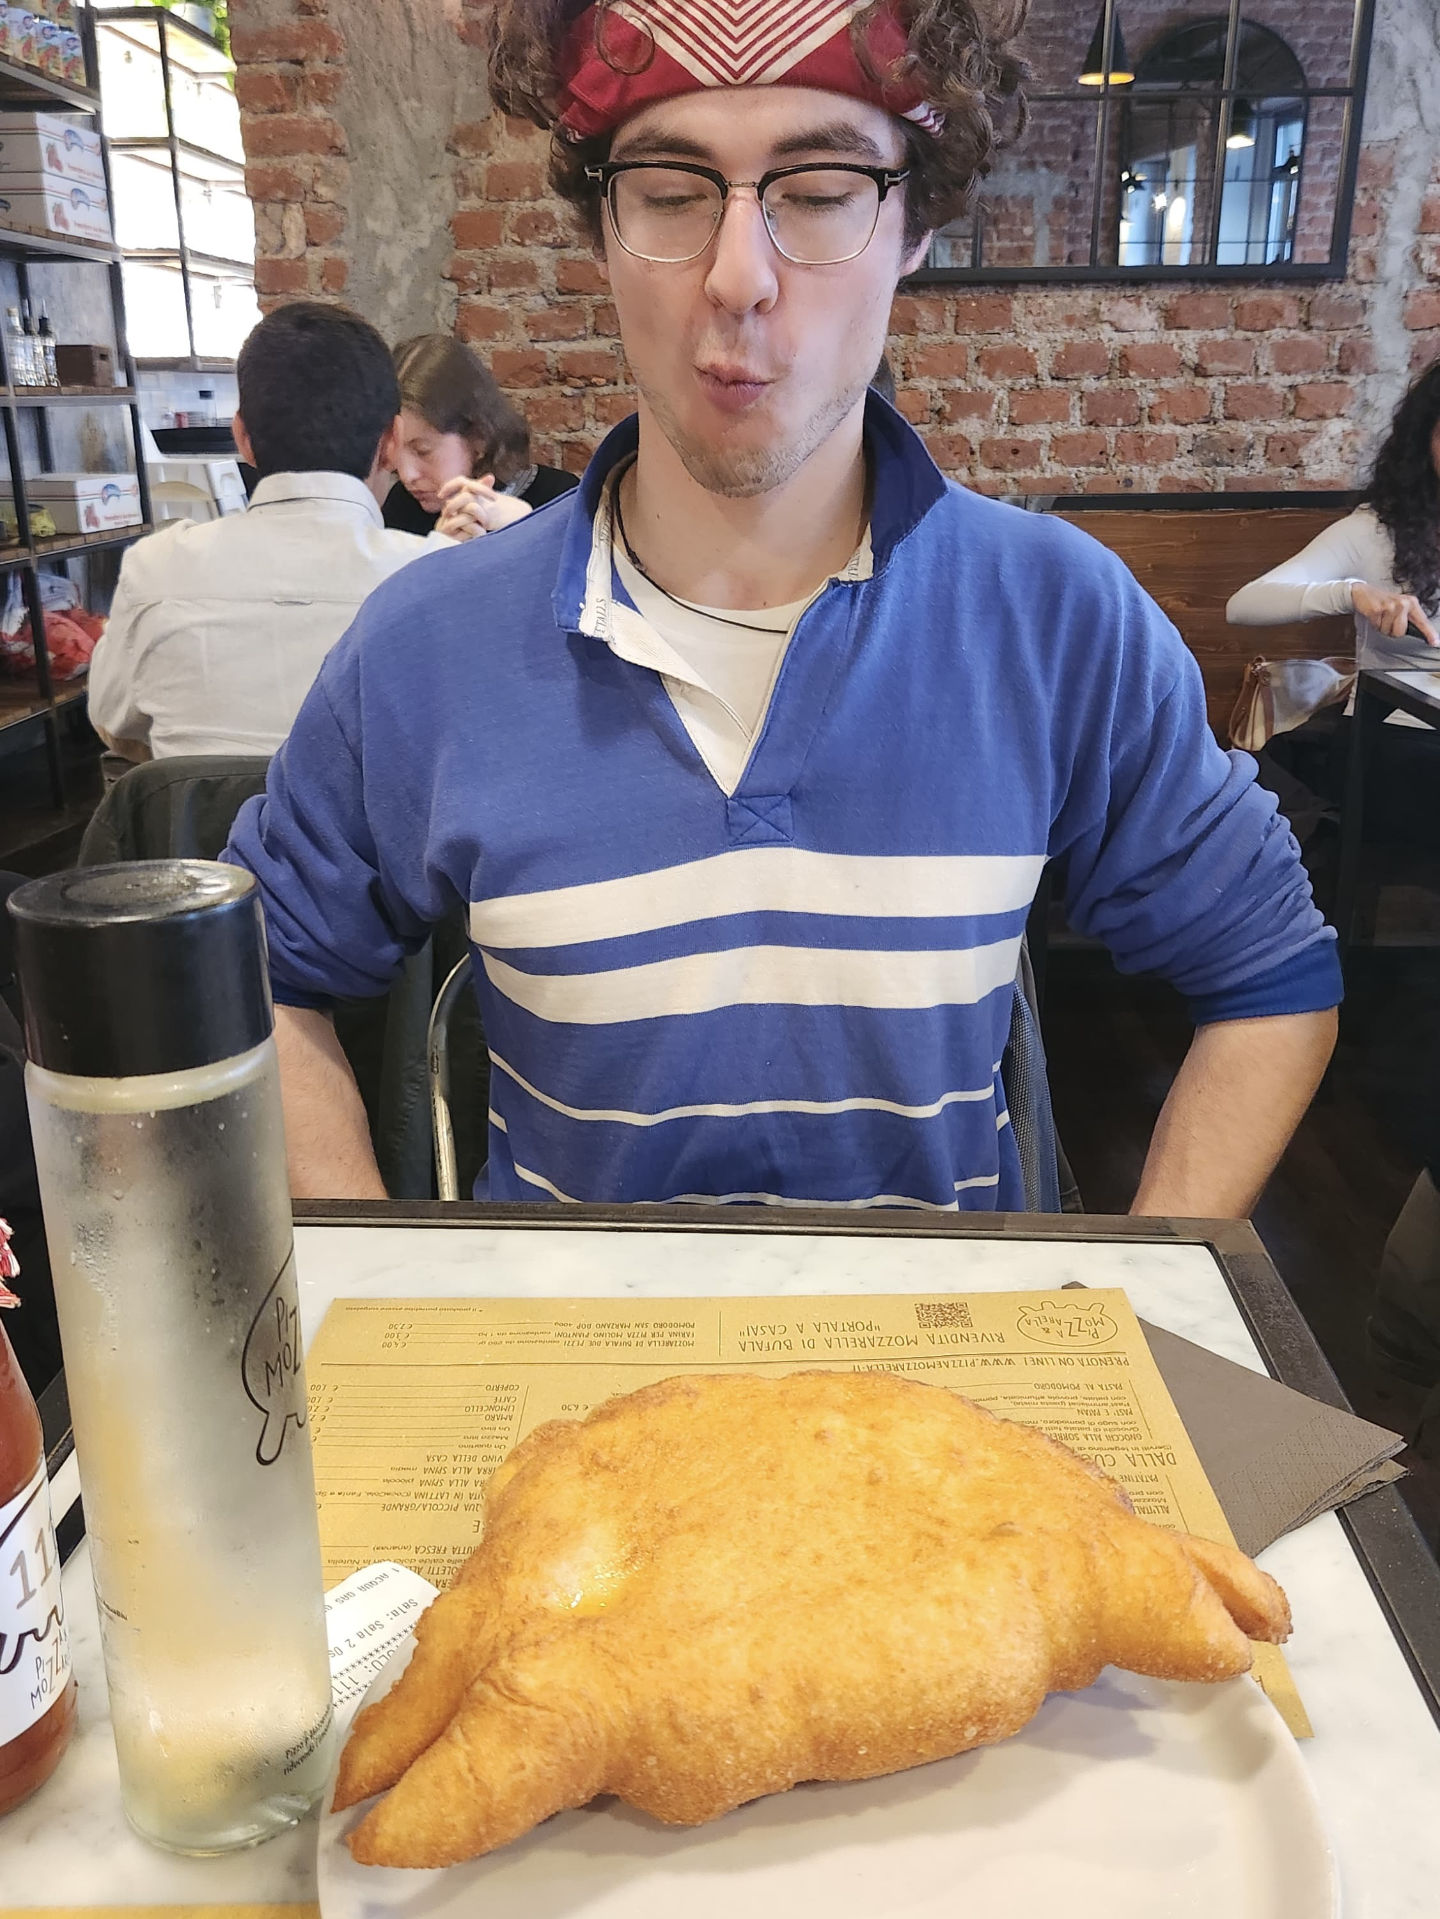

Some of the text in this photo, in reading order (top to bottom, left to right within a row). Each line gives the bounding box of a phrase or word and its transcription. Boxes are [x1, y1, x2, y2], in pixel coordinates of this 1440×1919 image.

[594, 598, 608, 635] ETAILS
[796, 1322, 804, 1334] A
[812, 1320, 880, 1334] "PORTALA
[1024, 1316, 1104, 1338] MOZZARELLA
[738, 1332, 1005, 1352] RIVENDITA MOZZARELLA DI BUFALA
[1058, 1357, 1074, 1366] ON
[1077, 1356, 1129, 1367] PRENOTA
[1097, 1383, 1123, 1391] PASTA
[1082, 1433, 1103, 1442] ALLA
[1105, 1433, 1143, 1442] GNOCCHI
[426, 1455, 448, 1463] CASA
[1124, 1452, 1177, 1468] DALLA
[423, 1466, 448, 1475] SPINA
[449, 1466, 473, 1475] ALLA
[477, 1466, 496, 1475] IRRA
[419, 1479, 445, 1487] SPINA
[446, 1479, 469, 1487] ALLA
[1119, 1474, 1159, 1483] PATATINE
[414, 1492, 450, 1500] LATTINA
[453, 1492, 464, 1500] IN
[381, 1503, 459, 1512] PICCOLA/GRANDE
[1132, 1505, 1170, 1515] ALL'ITALI
[415, 1545, 447, 1554] FRESCA
[428, 1566, 458, 1575] OLETTI
[385, 1598, 419, 1621] Sala:
[355, 1619, 385, 1642] Sala
[344, 1638, 356, 1649] 2
